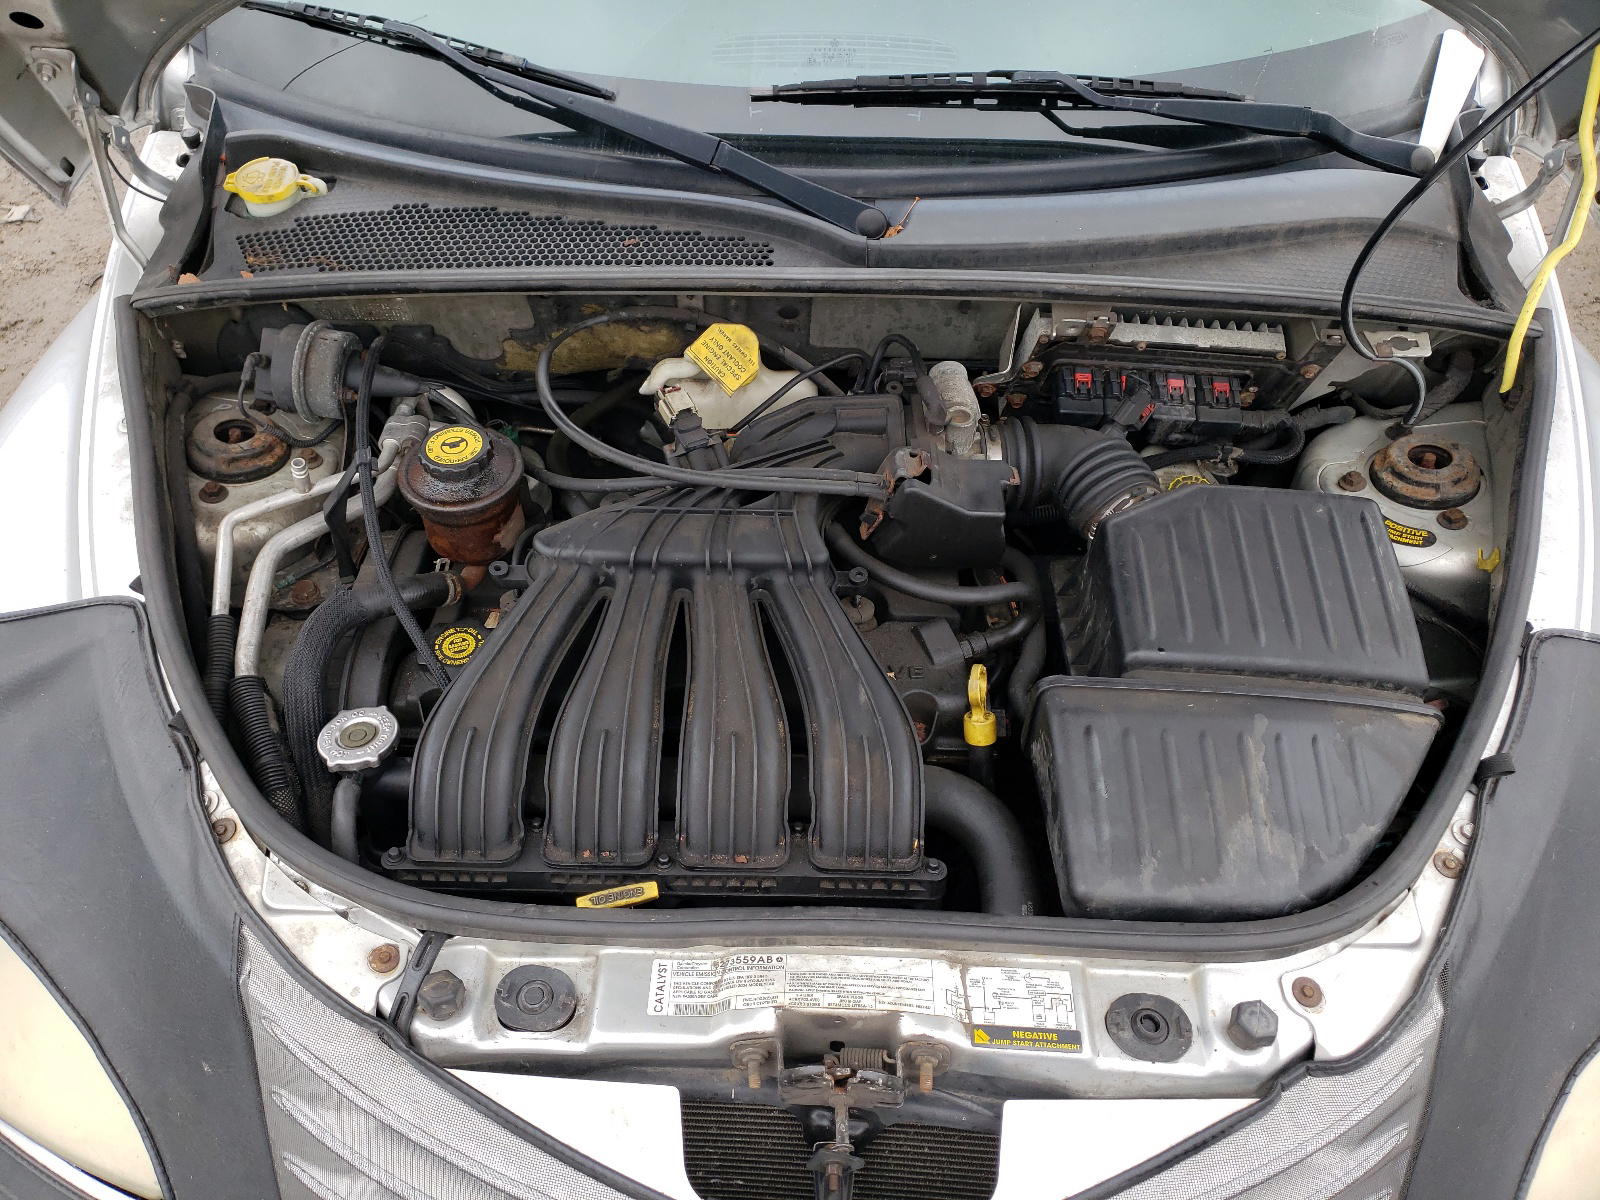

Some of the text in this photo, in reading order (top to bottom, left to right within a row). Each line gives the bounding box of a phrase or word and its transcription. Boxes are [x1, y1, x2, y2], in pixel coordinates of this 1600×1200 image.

[700, 339, 742, 381] SPECIAL ENGINE
[709, 336, 747, 373] COOLANT ONLY
[703, 355, 726, 378] CAUTION
[1384, 519, 1429, 537] POSITIVE
[589, 886, 643, 905] ENGINE OIL
[653, 962, 668, 1013] CATALYST
[991, 1038, 1081, 1051] JUMP START ATTACHMENT
[1012, 1030, 1058, 1041] NEGATIVE
